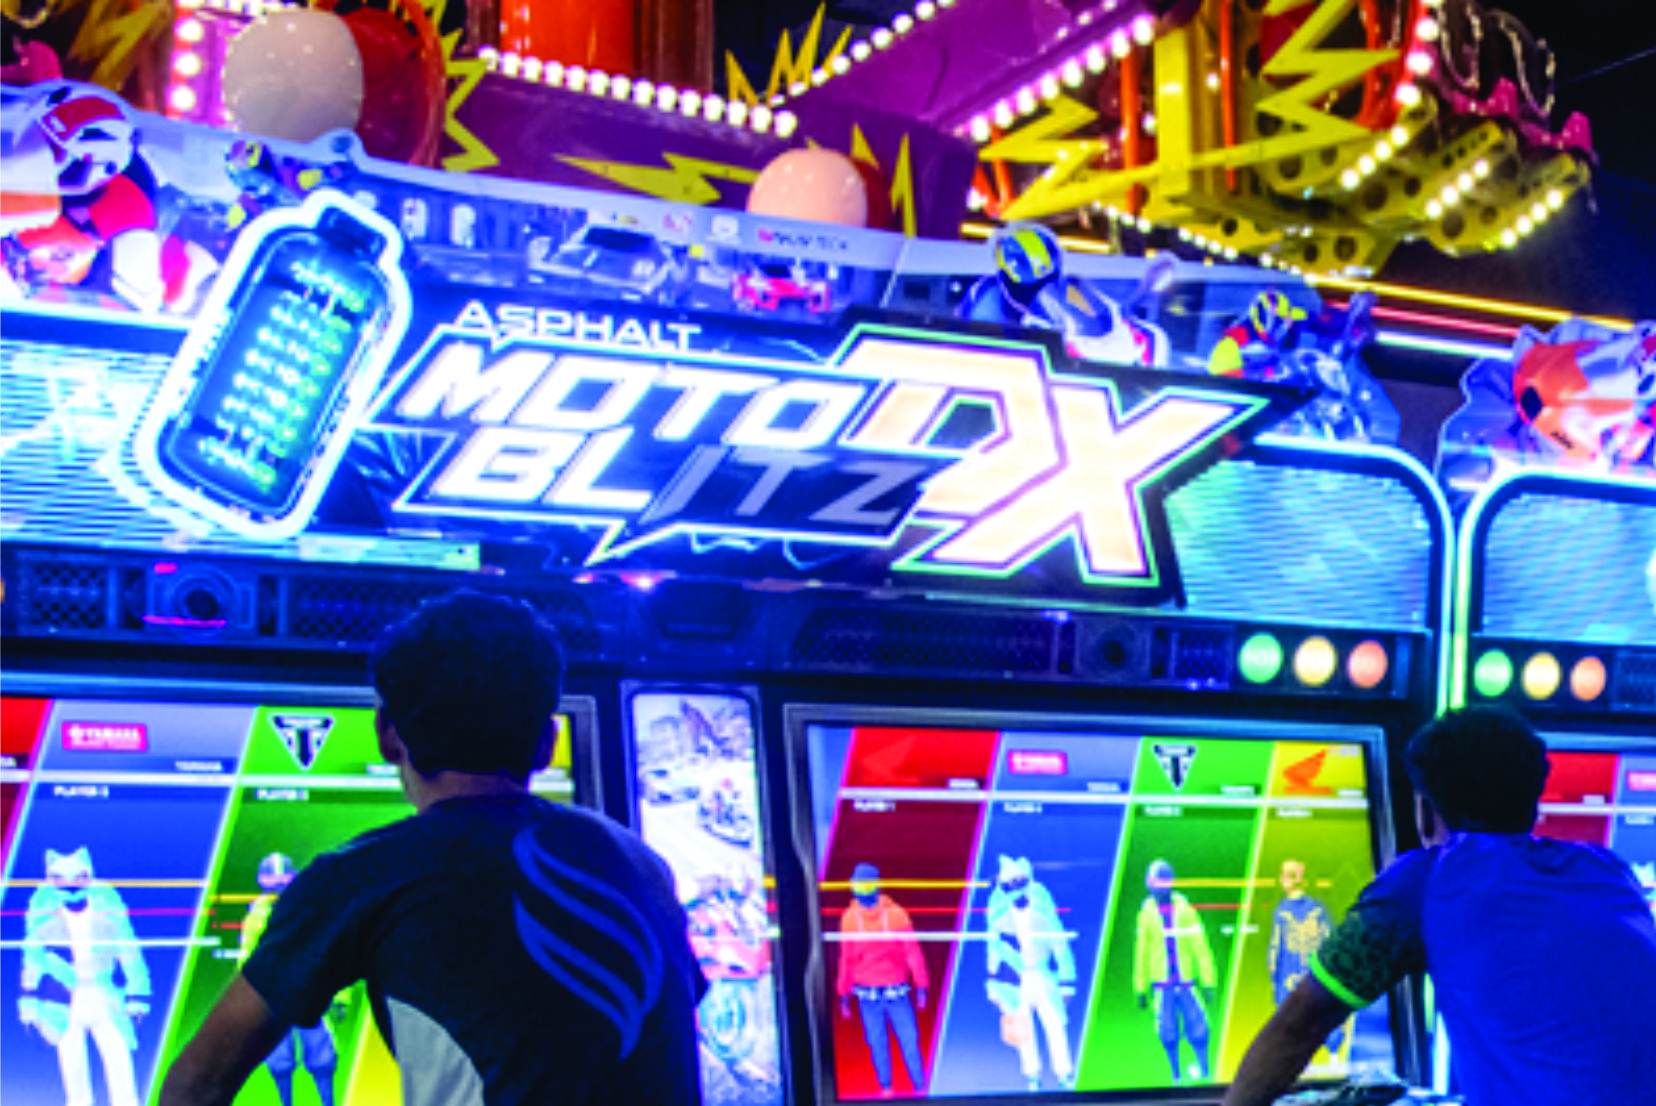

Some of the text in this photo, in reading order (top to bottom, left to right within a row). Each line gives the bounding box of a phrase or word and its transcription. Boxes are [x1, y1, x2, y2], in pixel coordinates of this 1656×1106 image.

[453, 298, 702, 352] ASPHALT
[394, 332, 1254, 582] MOTO DX
[426, 425, 931, 526] BLITZ
